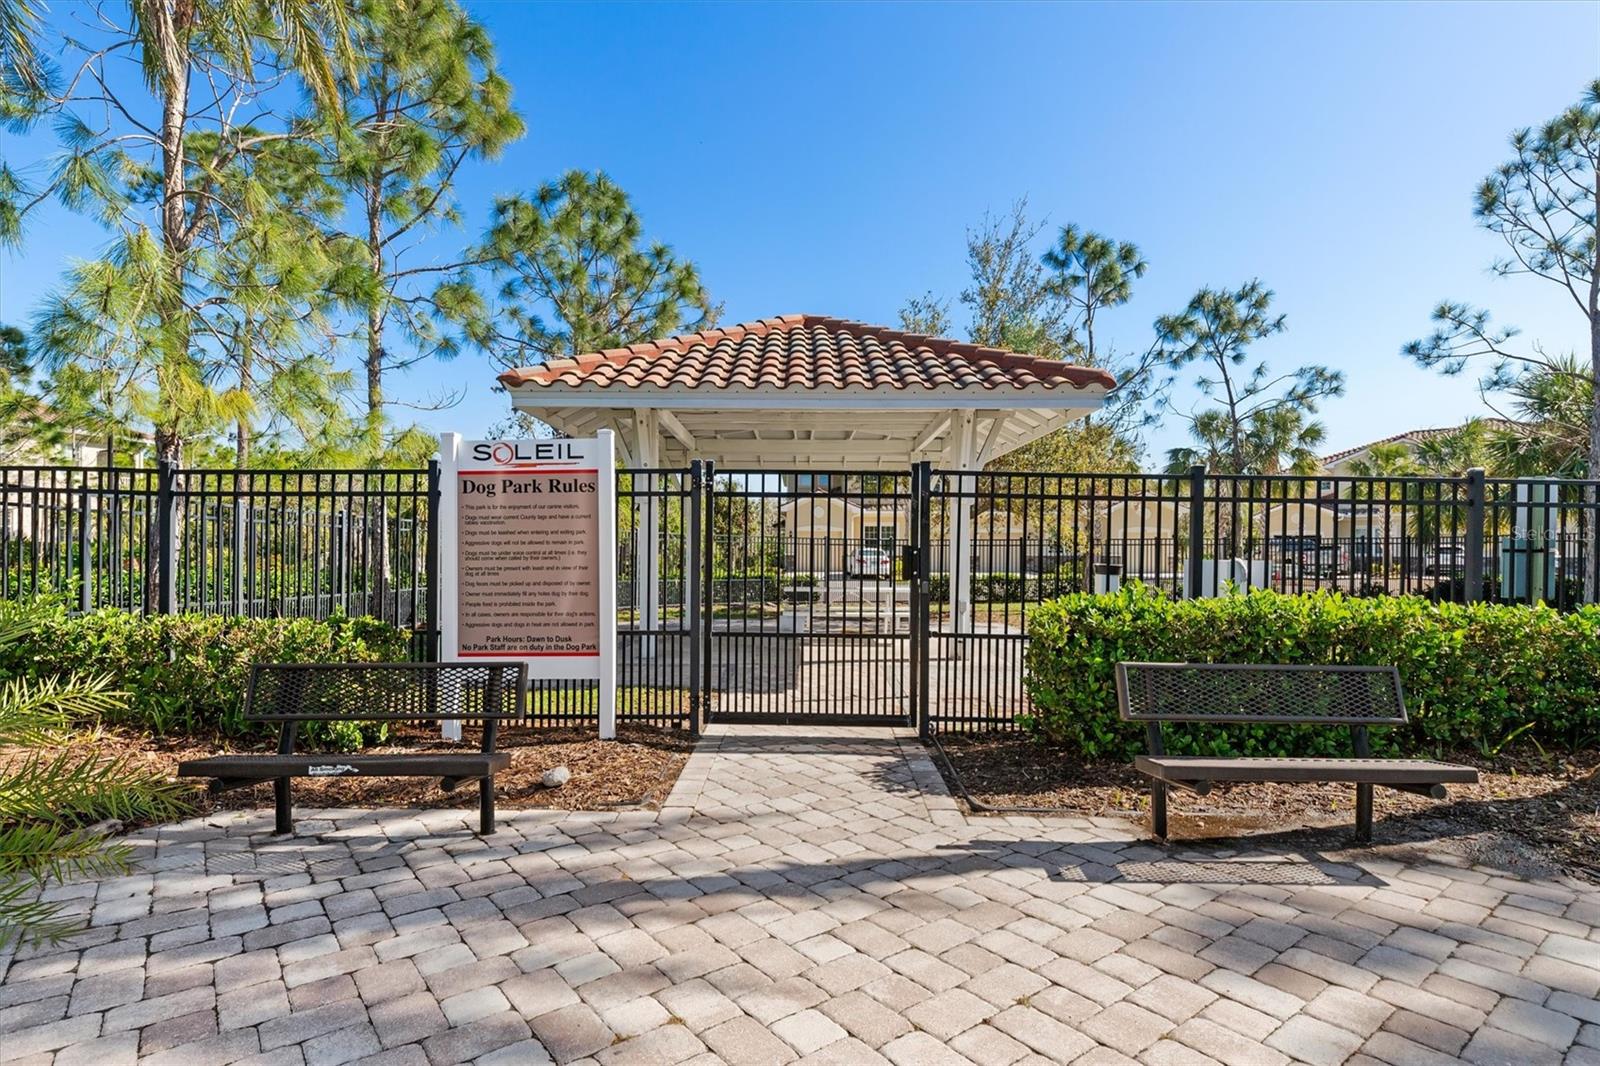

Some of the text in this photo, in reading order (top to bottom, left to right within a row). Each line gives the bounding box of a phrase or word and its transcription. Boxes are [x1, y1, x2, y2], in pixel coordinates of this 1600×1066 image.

[472, 442, 585, 465] SOLEIL
[462, 478, 596, 498] Dog Park Rules
